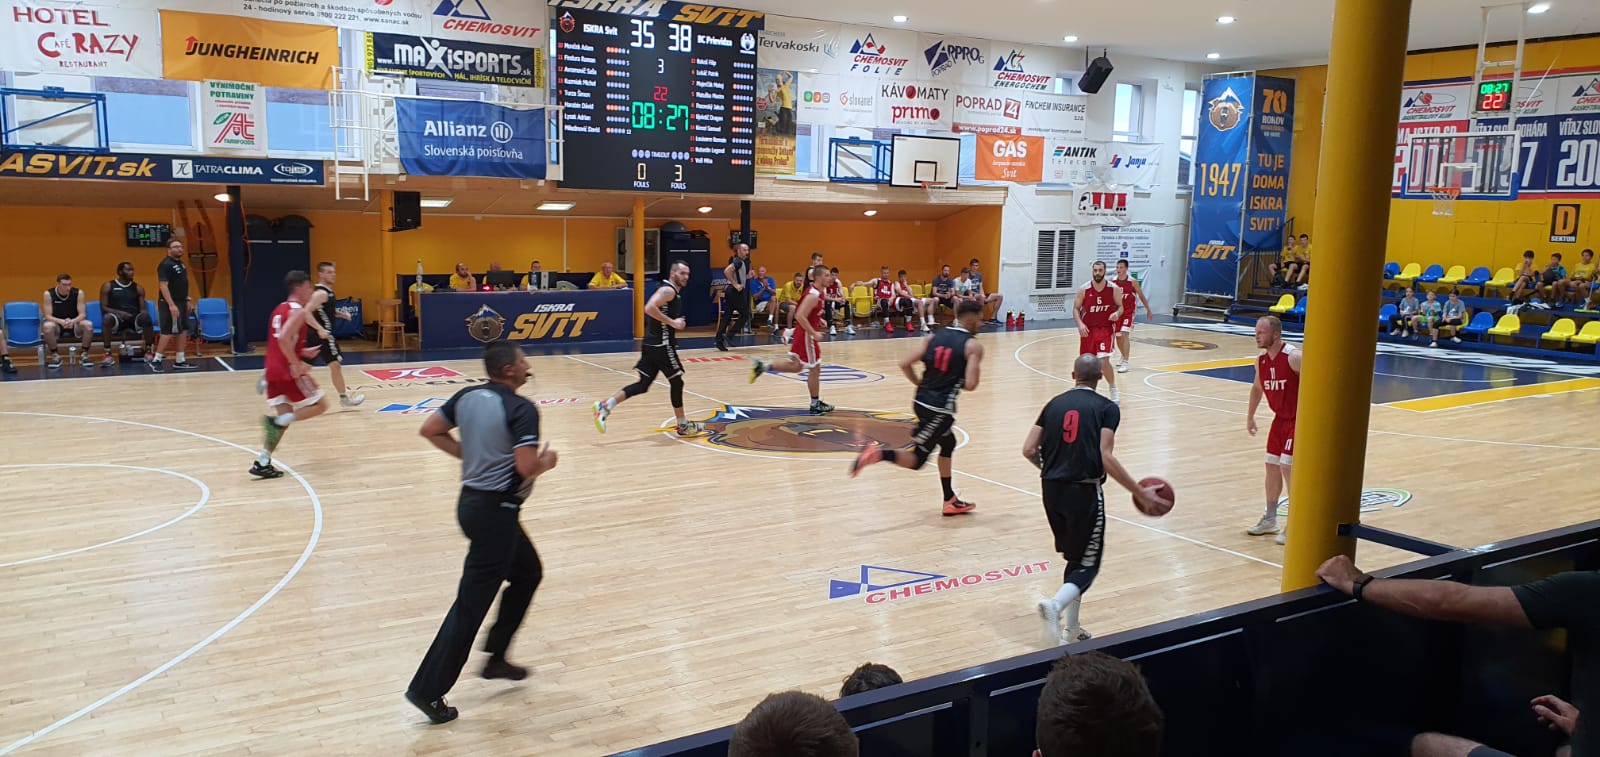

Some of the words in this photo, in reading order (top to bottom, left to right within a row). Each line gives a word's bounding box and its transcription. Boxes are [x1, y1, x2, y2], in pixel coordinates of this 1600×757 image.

[13, 7, 110, 27] HOTEL
[672, 4, 764, 28] SVIT
[442, 18, 541, 39] CHEMOSVIT
[583, 23, 604, 34] ISKRA
[604, 25, 618, 36] Svit
[630, 19, 655, 48] 35
[668, 23, 692, 52] 38
[759, 36, 819, 53] Tervakoski
[185, 40, 319, 65] JUNGHEINRICH
[58, 60, 107, 68] RESTAURANT
[658, 58, 665, 74] 3
[854, 54, 909, 67] CHEMOSVIT
[850, 64, 903, 76] FOLIE
[993, 80, 1048, 90] ENERGOCHEM
[997, 72, 1051, 84] CHEMOSVIT
[210, 90, 255, 100] POTRAVINY
[653, 86, 668, 101] 22
[881, 82, 949, 101] KÁVOMATY
[1481, 83, 1509, 94] 08:27
[956, 95, 1002, 111] POPRAD
[1005, 99, 1019, 119] 24
[1025, 100, 1052, 111] FINCHEM
[1052, 103, 1086, 112] INSURANCE
[1262, 89, 1287, 114] 70
[1482, 94, 1503, 109] 22
[632, 101, 689, 131] 08:27
[891, 105, 940, 124] primo
[1407, 105, 1456, 114] CHEMOSVIT
[1261, 115, 1285, 126] ROKOV
[424, 120, 487, 138] Allianz
[424, 144, 475, 157] Slovenská
[477, 145, 524, 161] poisťovňa
[993, 140, 1027, 158] GAS
[1064, 146, 1097, 158] ANTIK
[1052, 158, 1097, 166] telecom
[1258, 153, 1272, 168] TU
[1273, 154, 1285, 171] JE
[194, 165, 264, 176] TATRACLIMA
[637, 163, 646, 180] 0
[674, 164, 683, 182] 3
[670, 182, 686, 190] FOULS
[1200, 163, 1242, 197] 1947
[1253, 175, 1285, 190] DOMA
[1250, 195, 1283, 210] ISKRA
[1250, 217, 1275, 231] SVIT
[1555, 205, 1577, 236] D
[1191, 244, 1236, 260] SVIT
[533, 303, 576, 312] ISKRA
[1097, 297, 1103, 305] 6
[1090, 305, 1110, 313] SVIT
[507, 311, 599, 340] SVIT
[1100, 342, 1106, 351] 6
[933, 345, 953, 373] 11
[1264, 379, 1287, 391] SVIT
[1063, 409, 1080, 444] 9
[865, 560, 1051, 605] CHEMOSVIT
